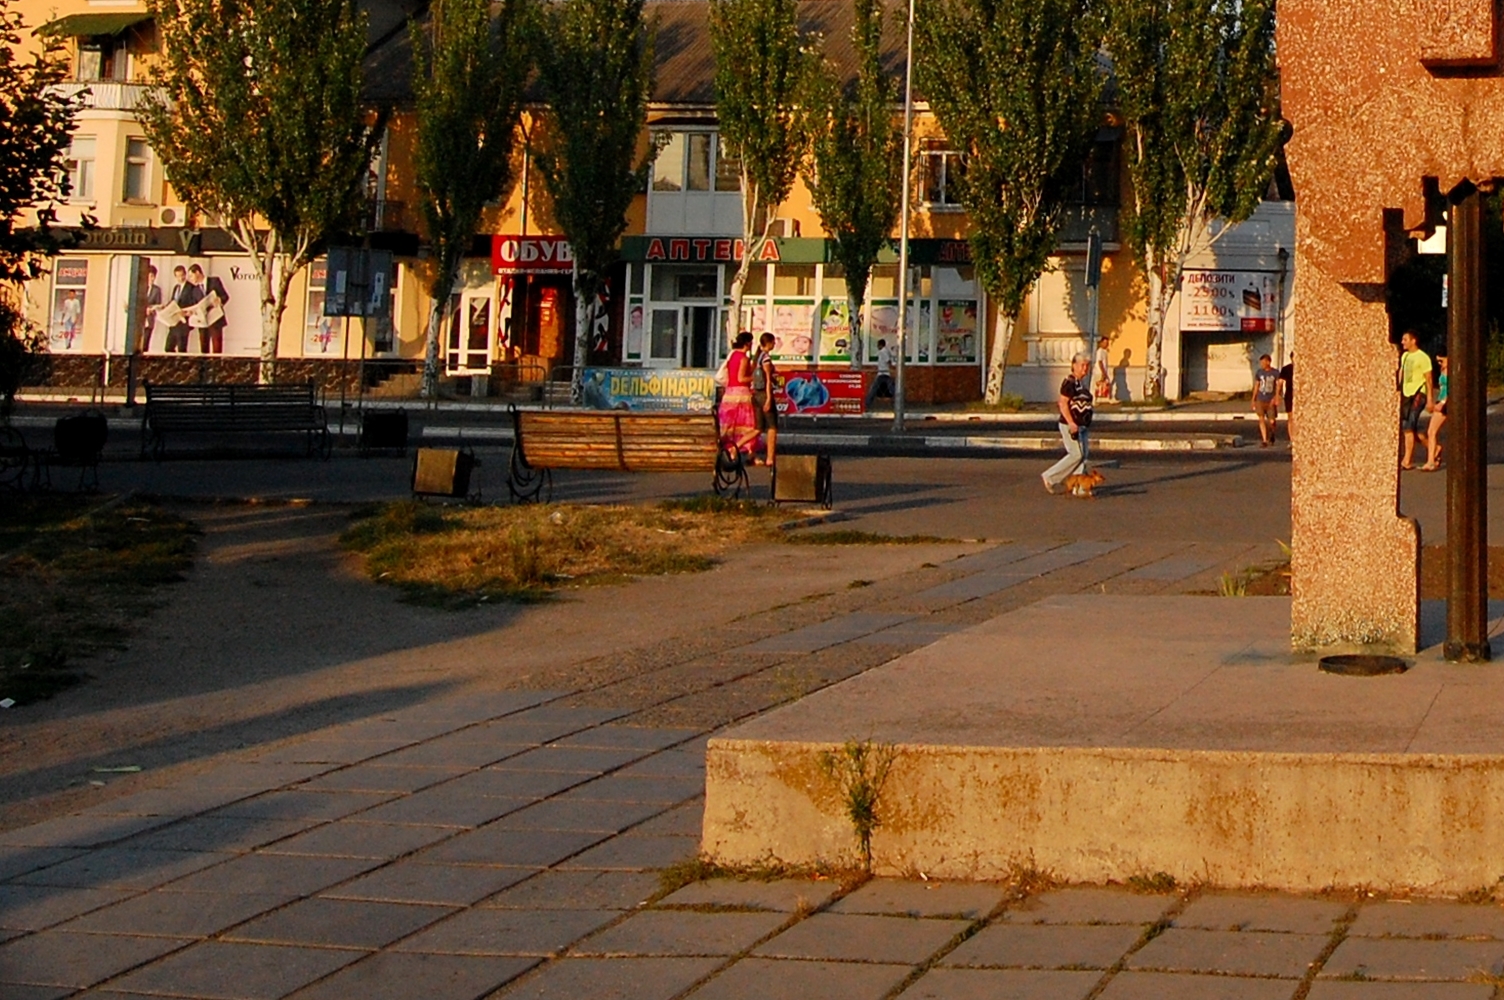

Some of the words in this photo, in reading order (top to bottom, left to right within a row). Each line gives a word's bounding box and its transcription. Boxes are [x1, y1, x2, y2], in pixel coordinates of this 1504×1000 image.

[82, 230, 147, 245] oronin
[500, 240, 574, 262] ОБУВ
[645, 238, 780, 261] АПТЕКА
[1187, 273, 1236, 284] ДЕПОЗИТИ
[779, 354, 806, 362] АПТЕКА
